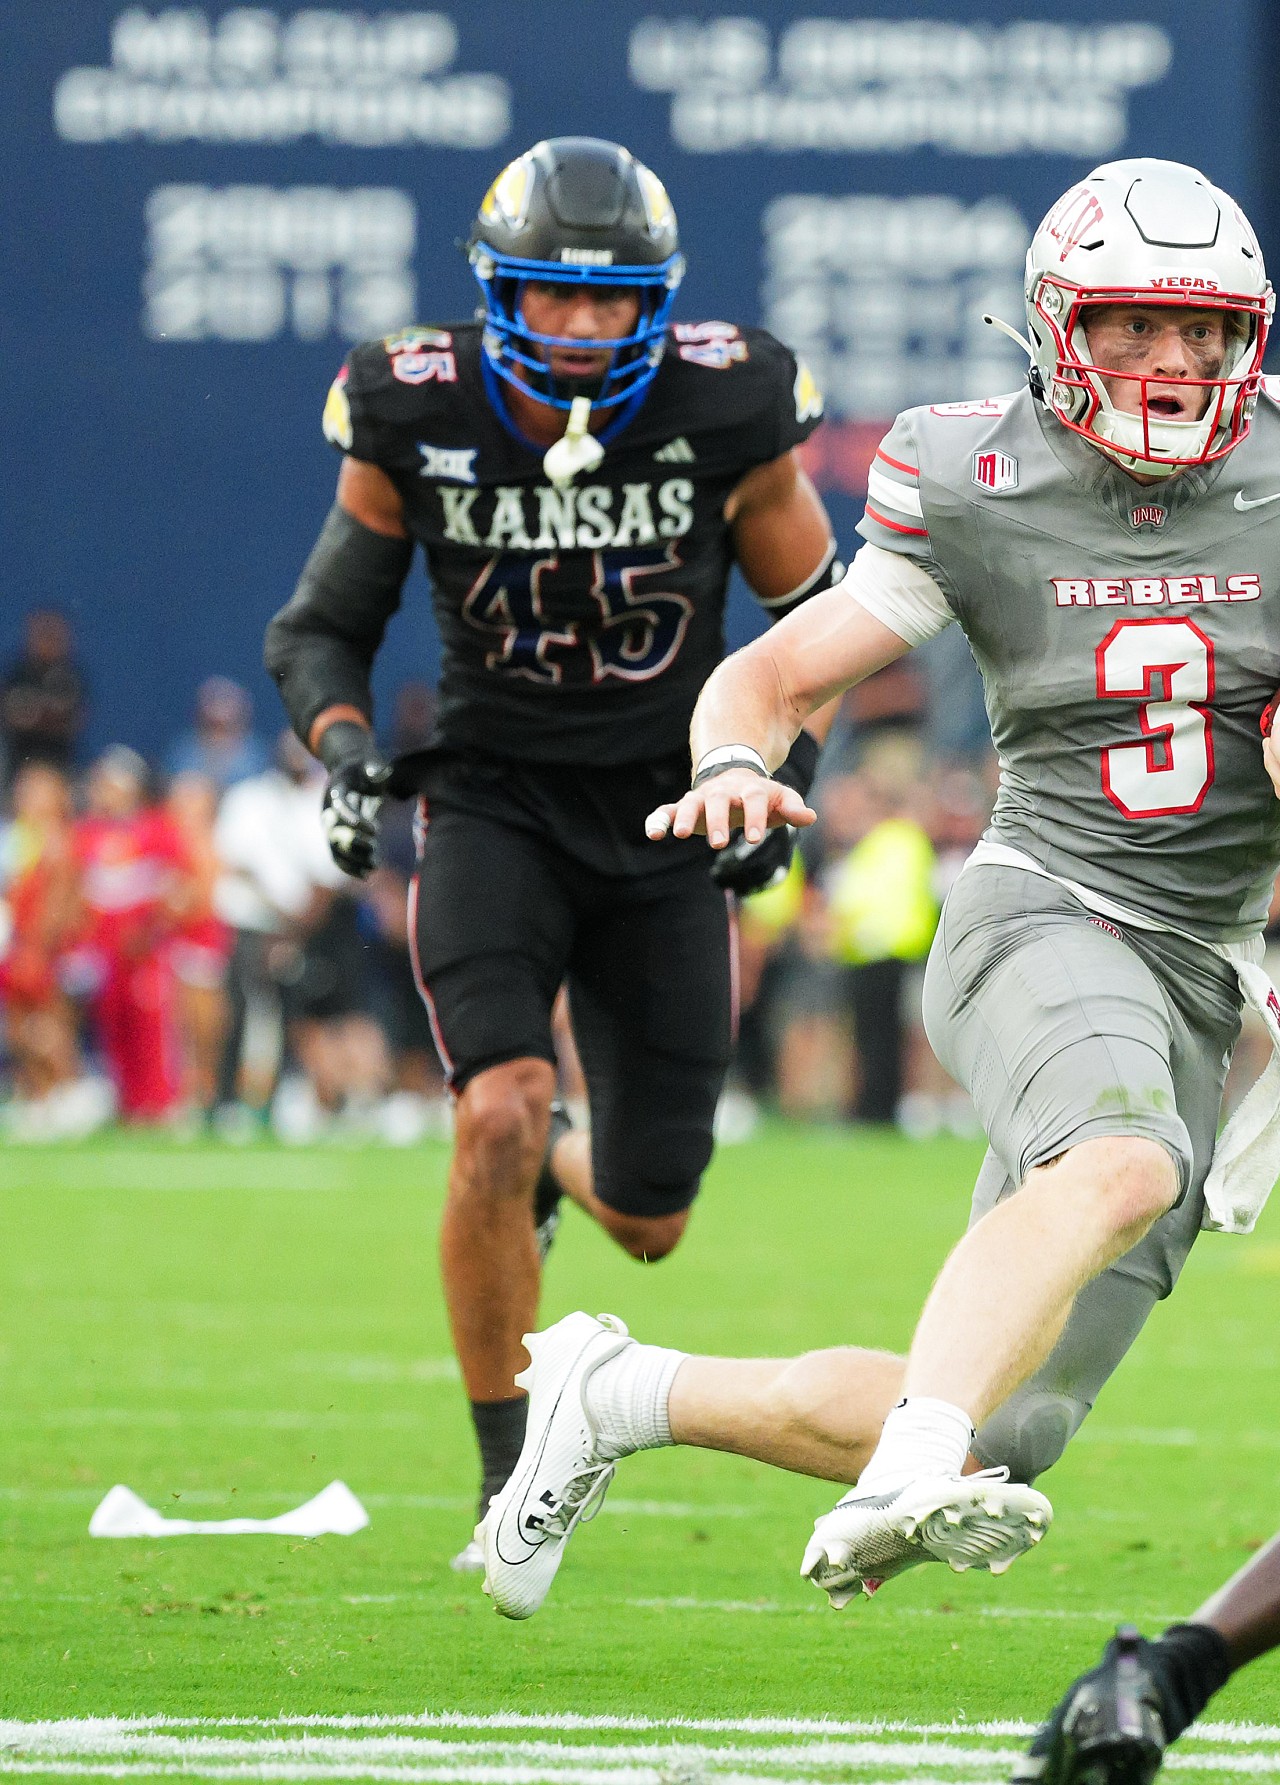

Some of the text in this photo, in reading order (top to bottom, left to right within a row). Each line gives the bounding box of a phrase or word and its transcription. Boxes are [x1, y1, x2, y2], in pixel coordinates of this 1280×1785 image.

[1149, 276, 1219, 291] VEGAS
[437, 478, 695, 550] KANSAS
[1132, 507, 1164, 526] UNLV
[461, 541, 695, 685] 45
[1050, 574, 1261, 607] REBELS
[1095, 616, 1215, 820] 3
